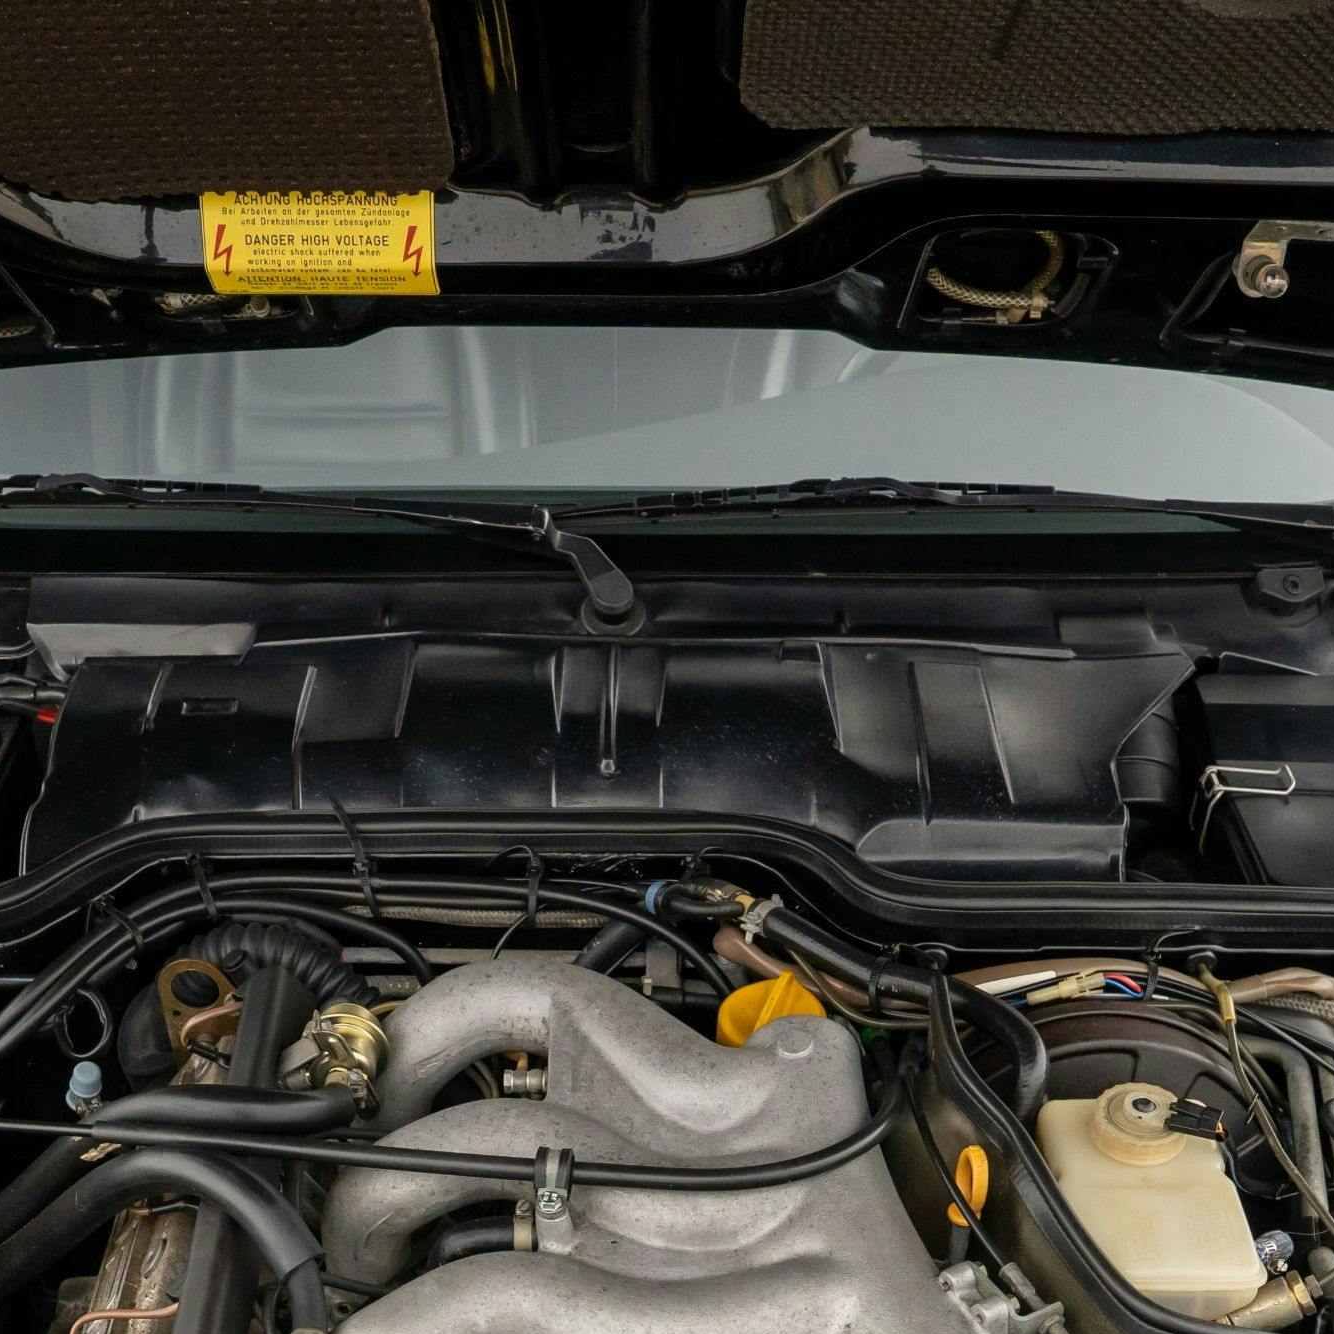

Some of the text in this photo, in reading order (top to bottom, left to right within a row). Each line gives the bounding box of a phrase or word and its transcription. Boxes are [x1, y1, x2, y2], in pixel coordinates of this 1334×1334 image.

[222, 207, 235, 216] Bei
[241, 207, 277, 216] Arbeiten
[297, 208, 310, 216] der
[315, 208, 356, 217] gesamten
[361, 208, 410, 217] Zündanlage
[260, 217, 328, 226] Drehzahlmesser
[334, 218, 392, 228] Lebensgefahr
[245, 235, 389, 246] DANGER HIGH VOLTAGE
[253, 248, 286, 256] electric
[290, 248, 314, 256] shock
[319, 248, 354, 256] suffered
[248, 258, 282, 267] working
[300, 258, 332, 267] ignition
